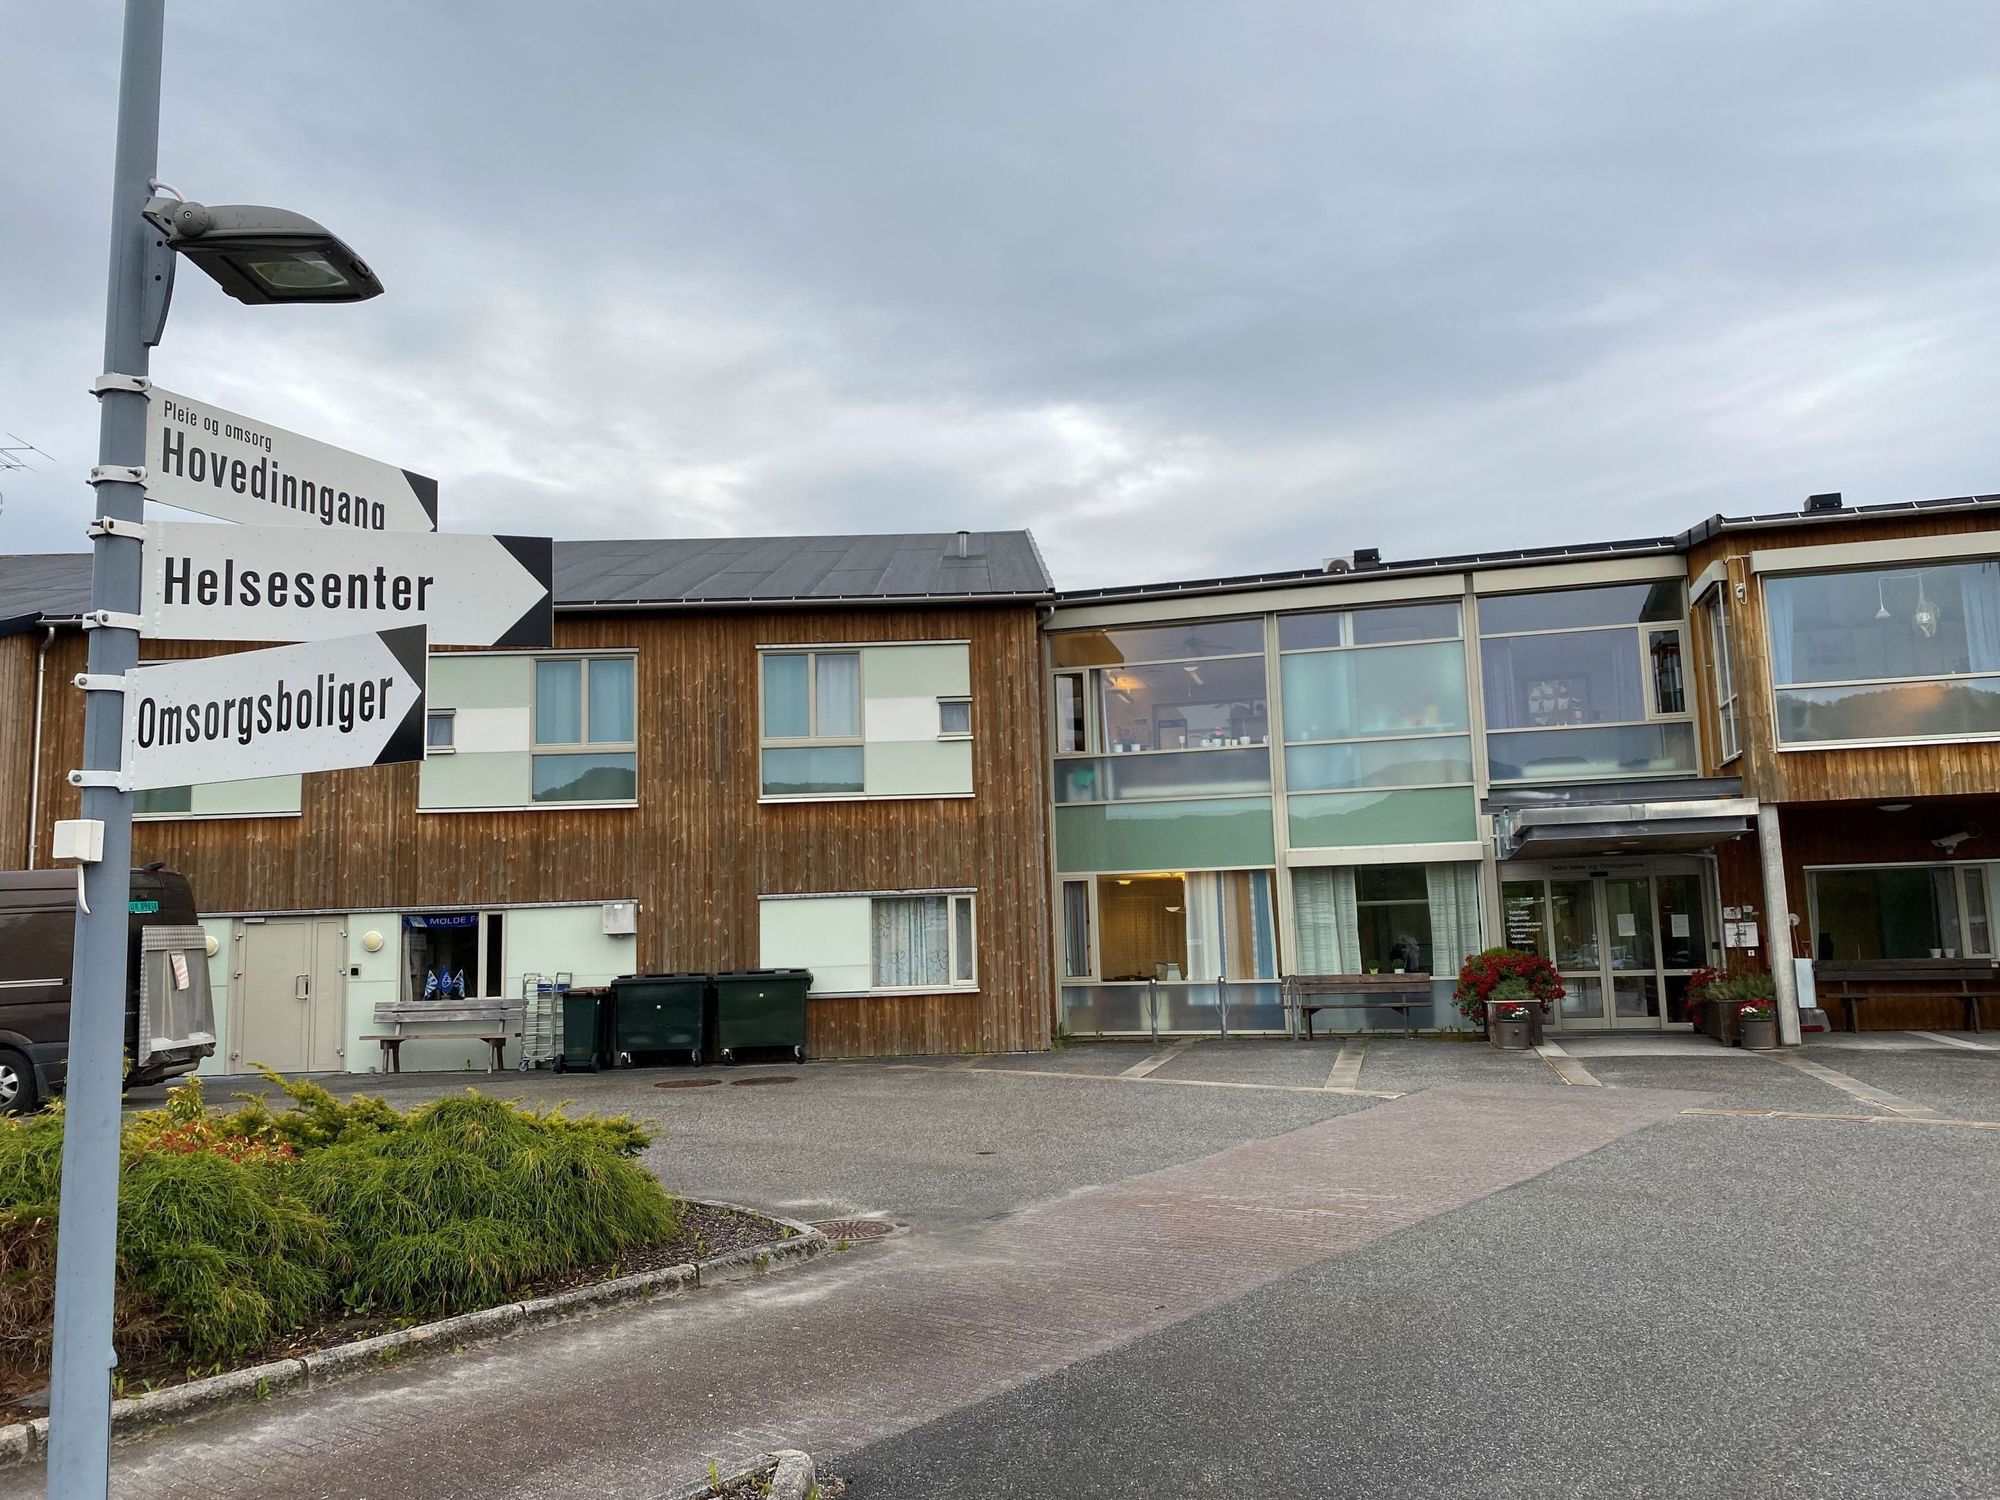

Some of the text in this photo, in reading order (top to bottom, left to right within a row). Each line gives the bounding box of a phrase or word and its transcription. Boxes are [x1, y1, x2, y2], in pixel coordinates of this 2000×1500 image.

[164, 400, 272, 453] Pleie og omsorg
[164, 557, 434, 611] Helsesenter
[138, 673, 393, 748] Omsorgsboliger
[429, 916, 466, 925] MOLDE
